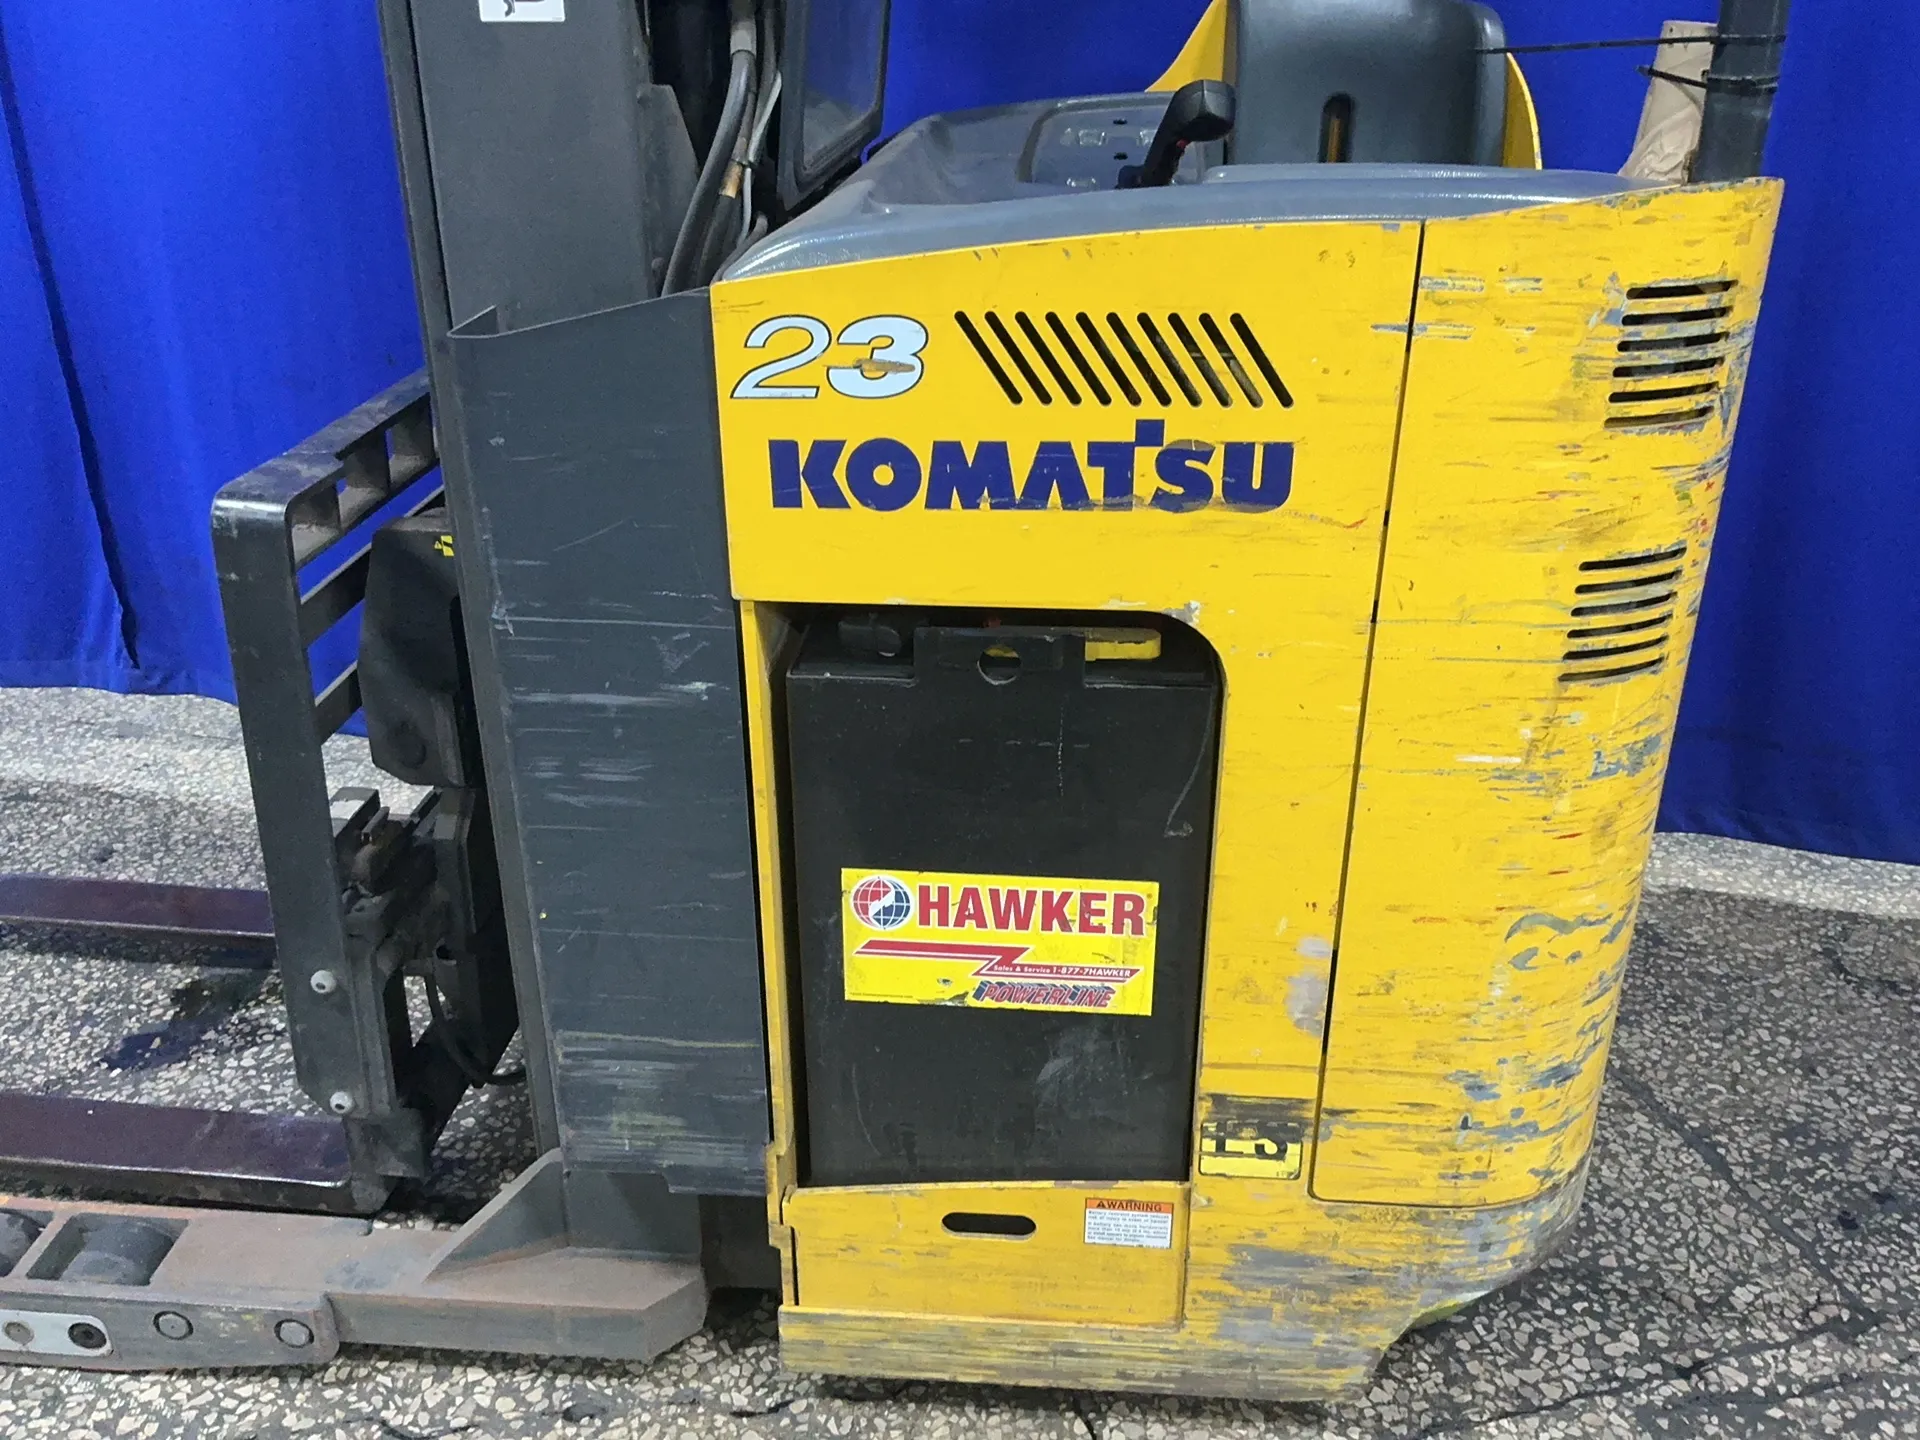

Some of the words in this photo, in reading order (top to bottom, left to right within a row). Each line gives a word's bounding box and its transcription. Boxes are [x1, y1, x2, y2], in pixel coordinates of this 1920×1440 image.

[730, 314, 929, 400] 23
[768, 419, 1295, 512] KOMATSU
[918, 885, 1146, 936] HAWKER
[993, 964, 1013, 972] Sales
[1024, 966, 1051, 974] Service
[973, 980, 1117, 1009] POWERLINE
[1106, 1200, 1162, 1212] WARNING
